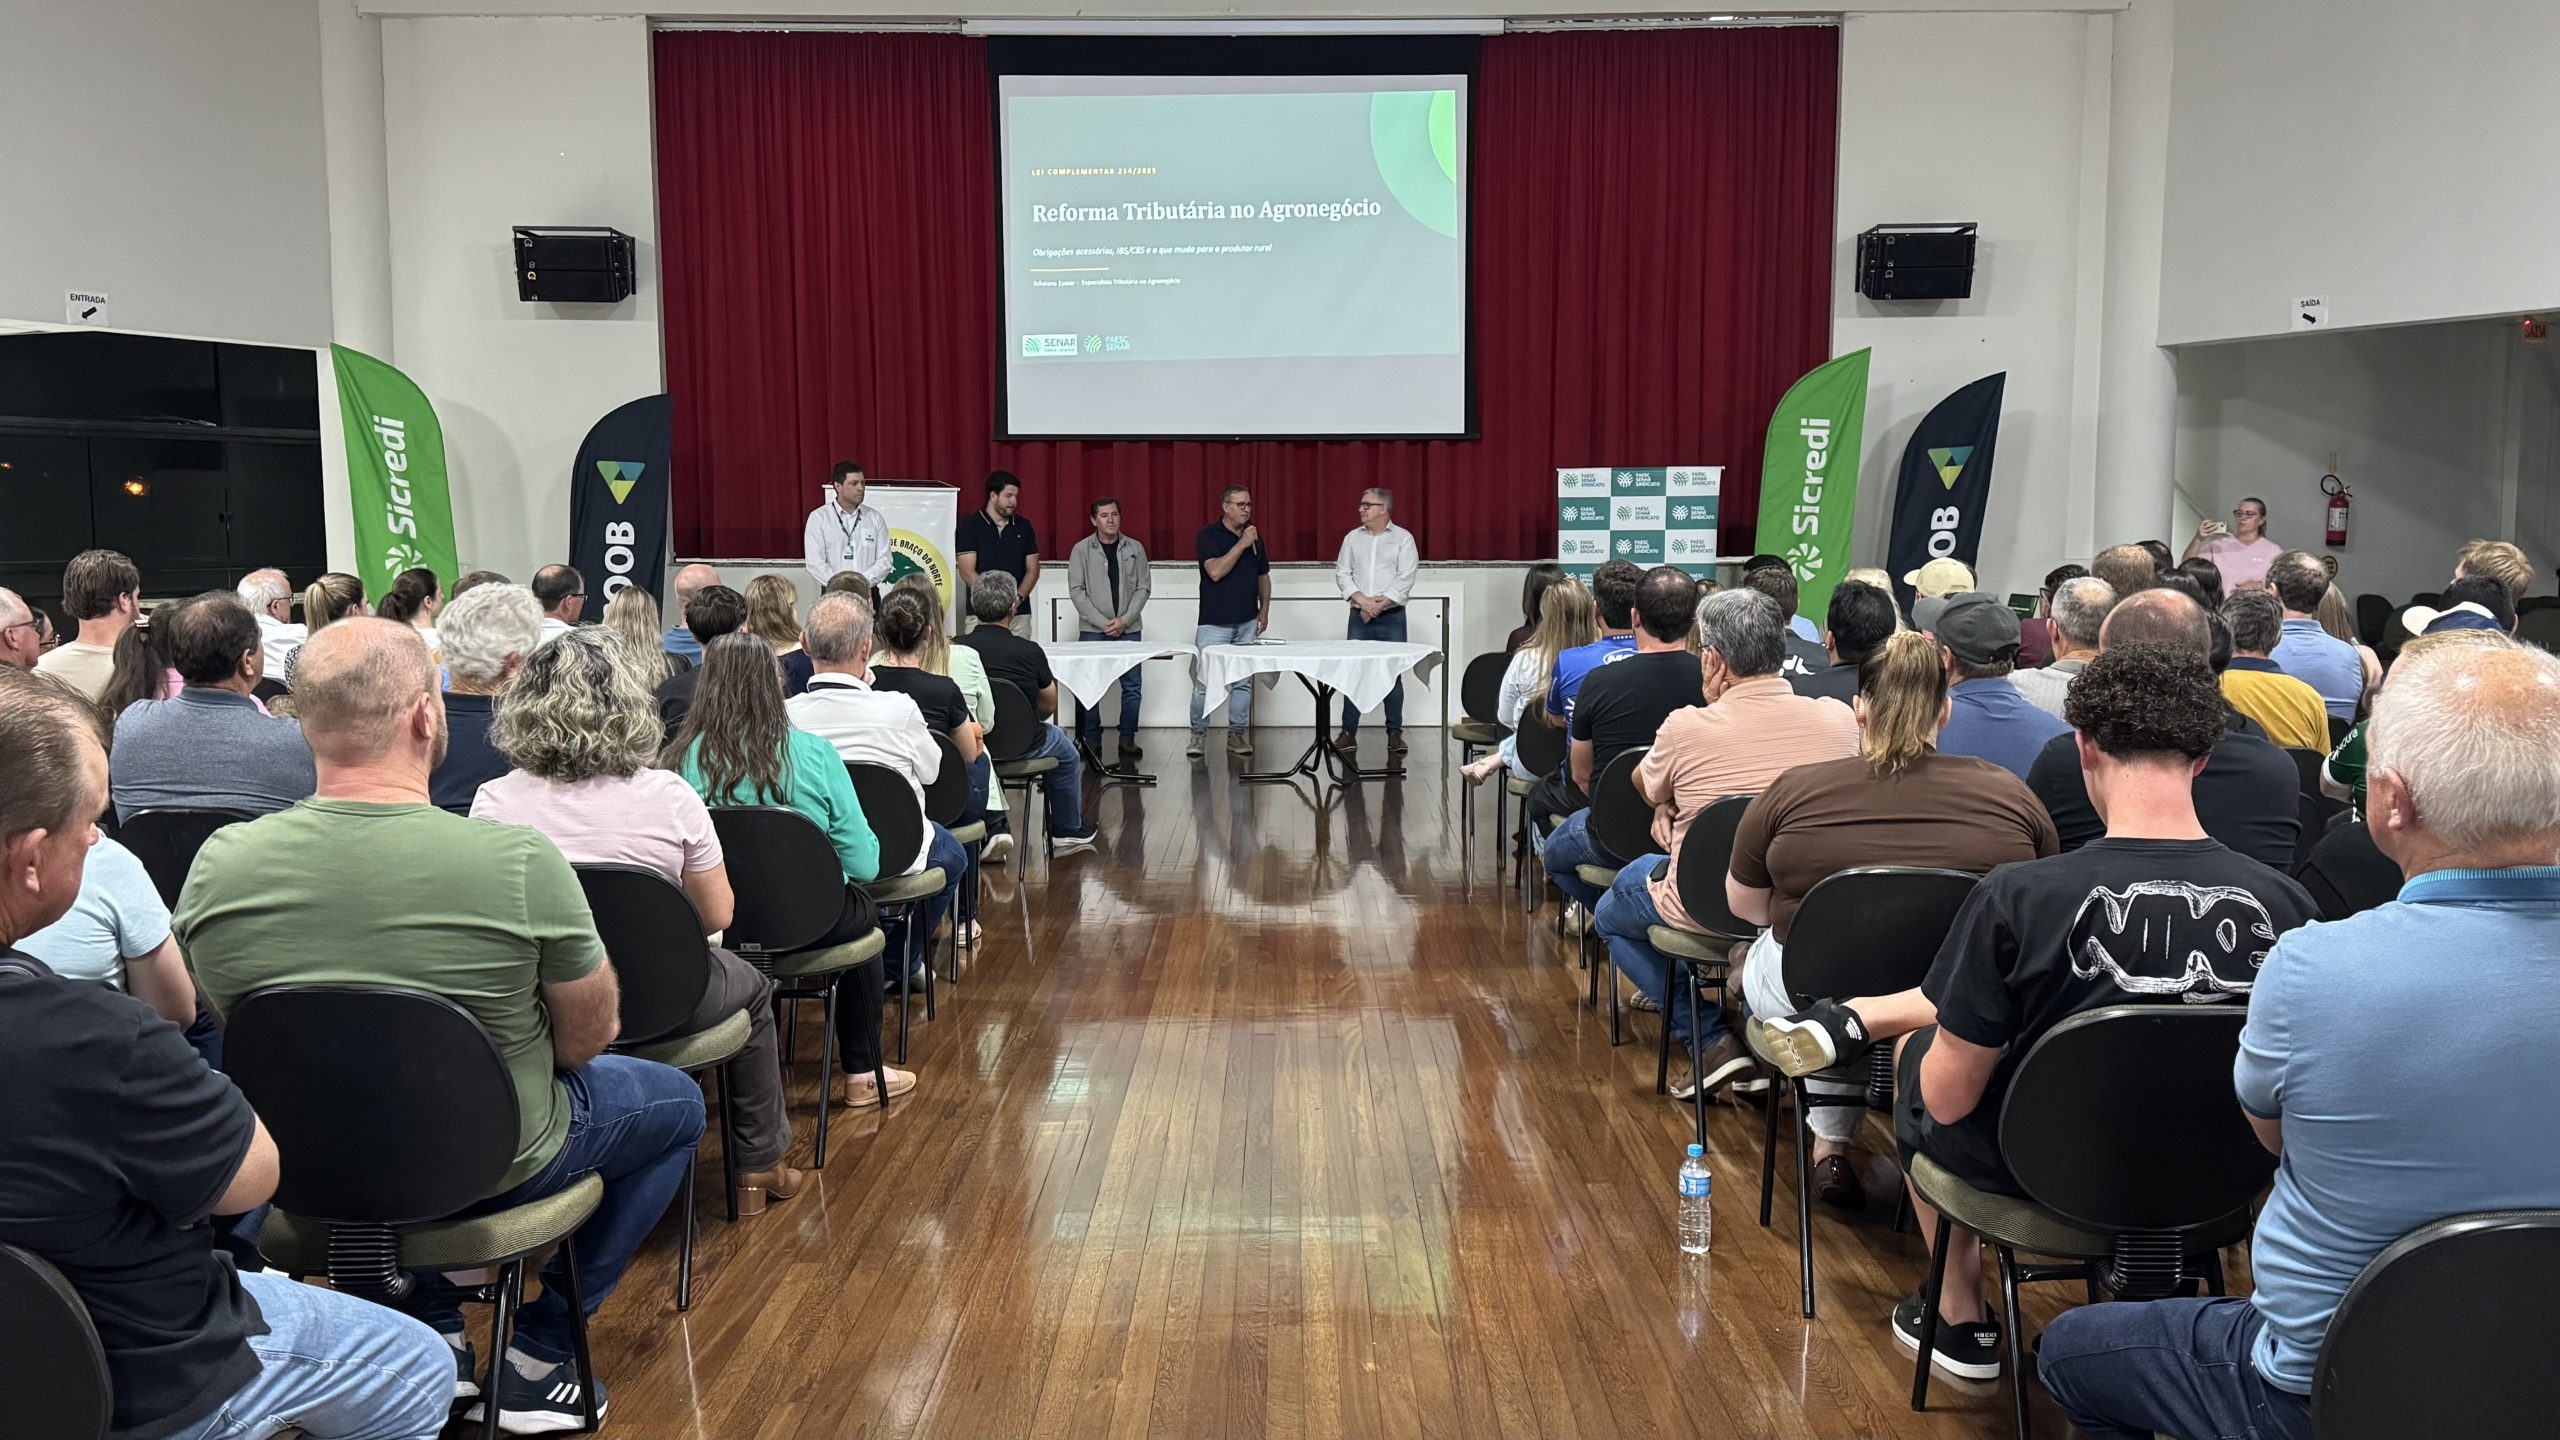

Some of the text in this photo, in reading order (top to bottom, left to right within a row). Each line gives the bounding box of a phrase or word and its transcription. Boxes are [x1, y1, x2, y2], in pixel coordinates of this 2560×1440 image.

[1032, 168, 1044, 176] LEI
[1048, 168, 1115, 176] COMPLEMENTAR
[1032, 198, 1382, 222] Reforma Tributária no Agronegócio
[1033, 247, 1074, 258] Obrigações
[1075, 247, 1115, 256] acessórias,
[1116, 246, 1145, 256] IBS/CBS
[1159, 247, 1173, 255] que
[1221, 245, 1253, 254] produtor
[1254, 244, 1272, 252] rural
[70, 293, 106, 304] ENTRADA
[2300, 298, 2320, 308] SAÍDA
[1044, 338, 1076, 347] SENAR
[373, 414, 416, 539] Sicredi
[1792, 418, 1830, 536] Sicredi
[900, 539, 923, 556] BRAÇO
[922, 553, 933, 565] DO
[929, 564, 943, 587] NORTE
